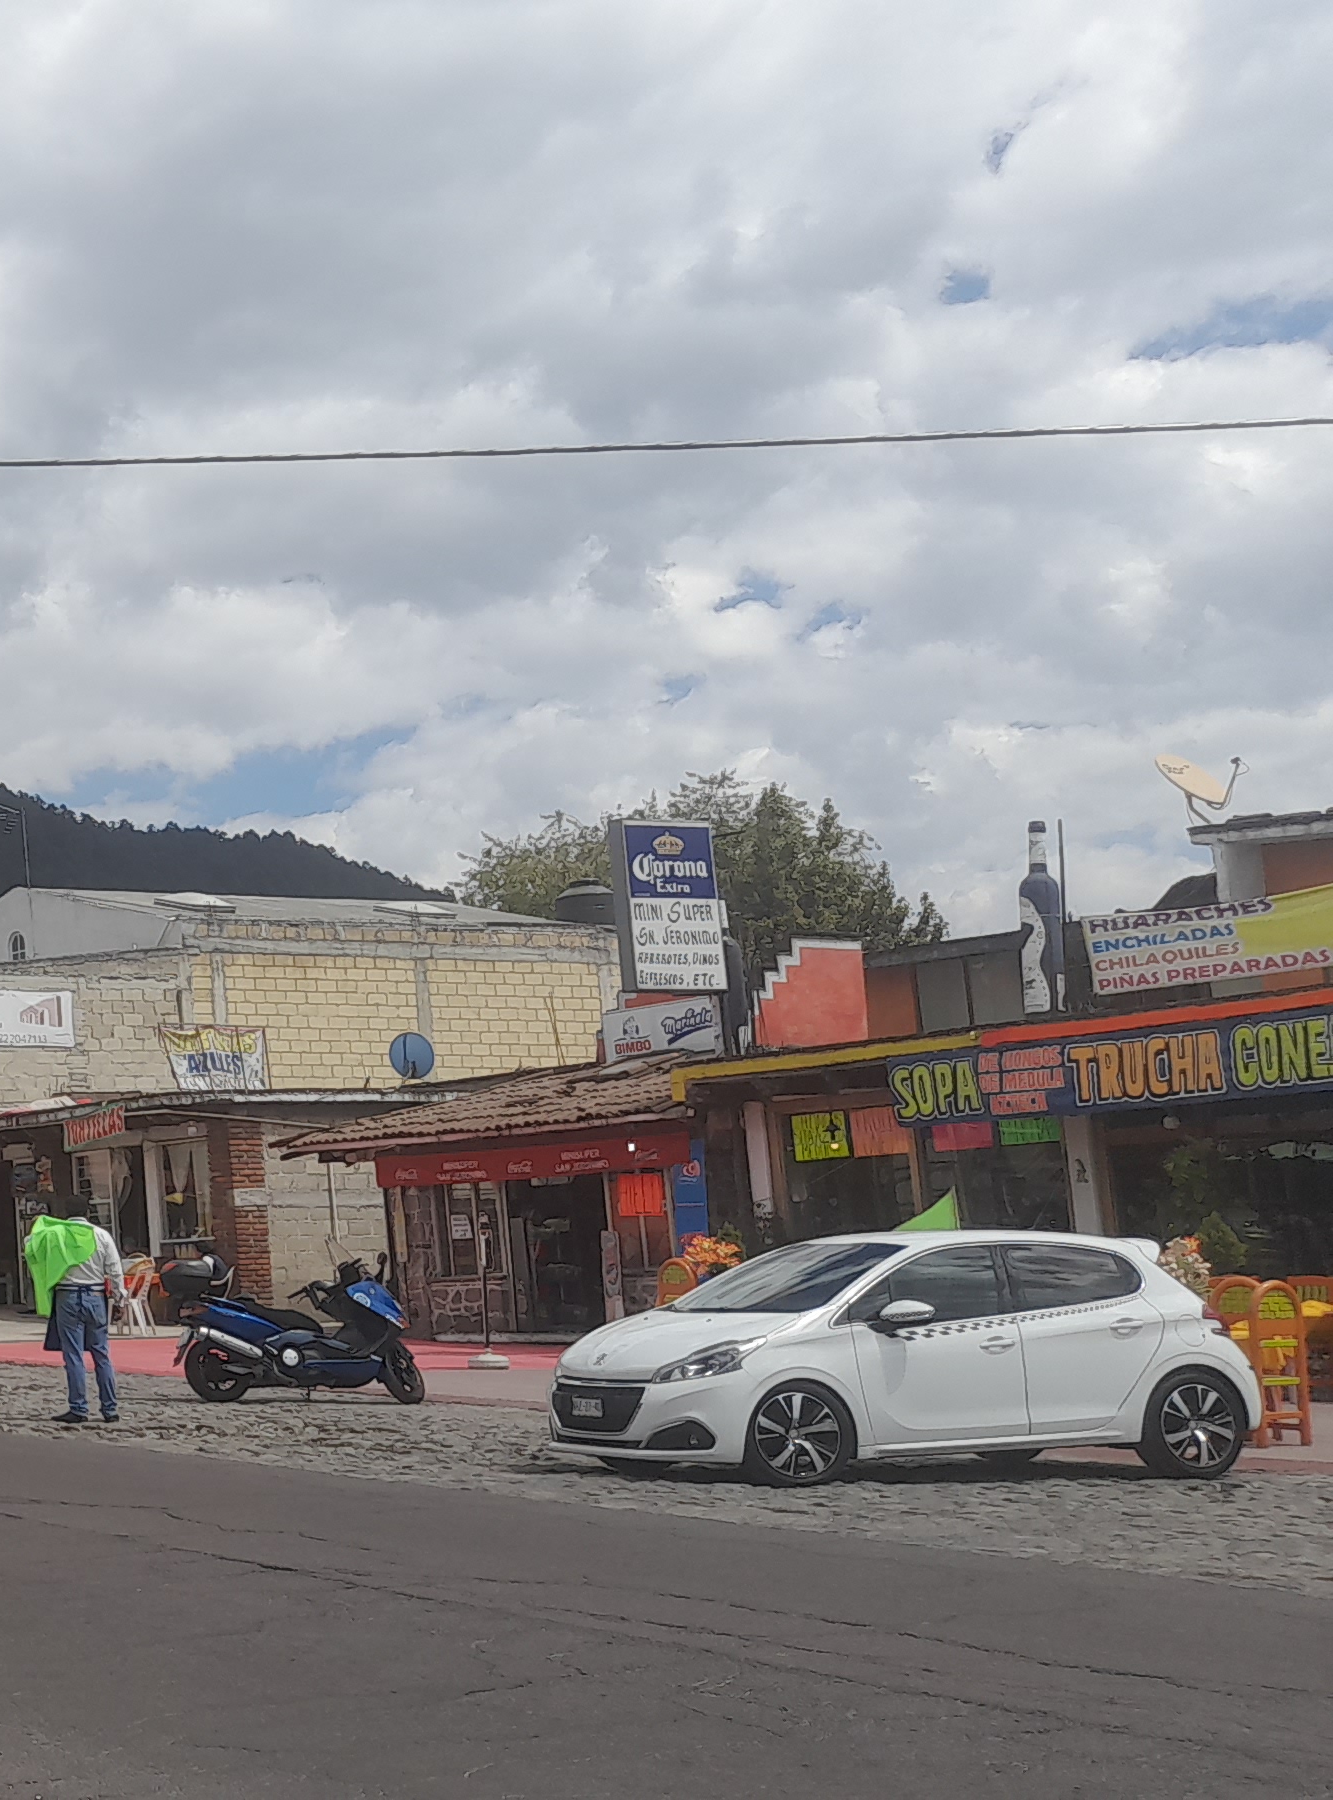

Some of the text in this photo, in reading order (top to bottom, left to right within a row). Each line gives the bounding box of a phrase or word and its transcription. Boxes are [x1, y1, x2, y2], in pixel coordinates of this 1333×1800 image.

[632, 853, 708, 884] Corona
[656, 878, 691, 893] Extra
[634, 903, 664, 921] MINI
[1088, 897, 1274, 934] HUARACHES
[662, 925, 719, 945] JERONIMO
[1092, 923, 1235, 954] ENCHILADAS
[1094, 941, 1240, 972] CHILAQUILES
[1097, 949, 1331, 991] PIÑAS PREPARADAS
[614, 1040, 651, 1055] BIMBO
[1231, 1015, 1333, 1090] CONE
[1003, 1067, 1064, 1092] MEDULA
[1066, 1030, 1226, 1105] TRUCHA
[889, 1058, 984, 1120] SOPA
[64, 1104, 125, 1149] TORTILLAS
